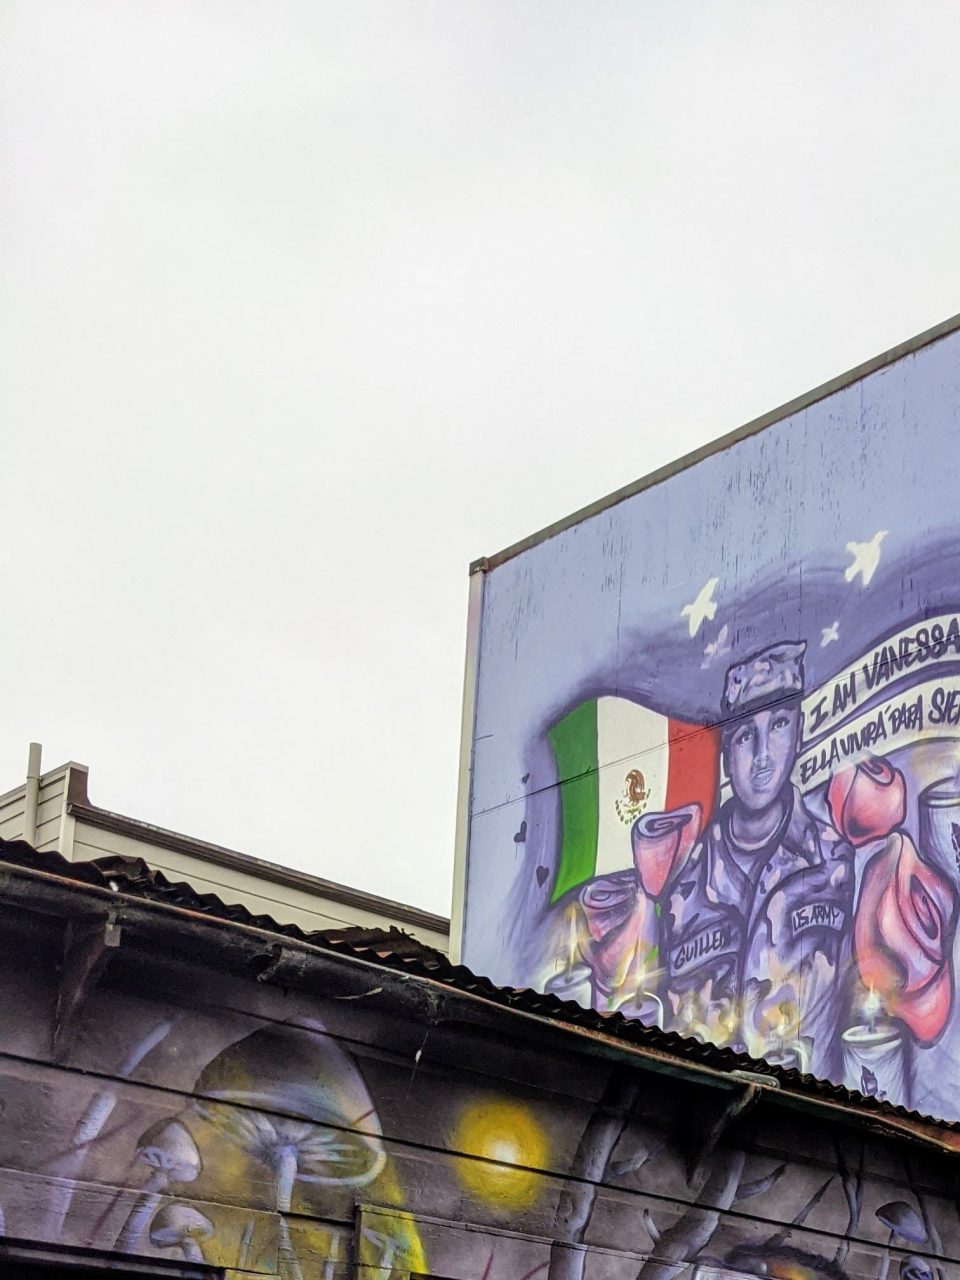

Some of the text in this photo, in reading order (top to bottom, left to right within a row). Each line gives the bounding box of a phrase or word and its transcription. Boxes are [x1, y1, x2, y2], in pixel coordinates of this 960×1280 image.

[809, 696, 829, 734] I
[831, 676, 857, 718] AM
[800, 737, 841, 785] ELLA
